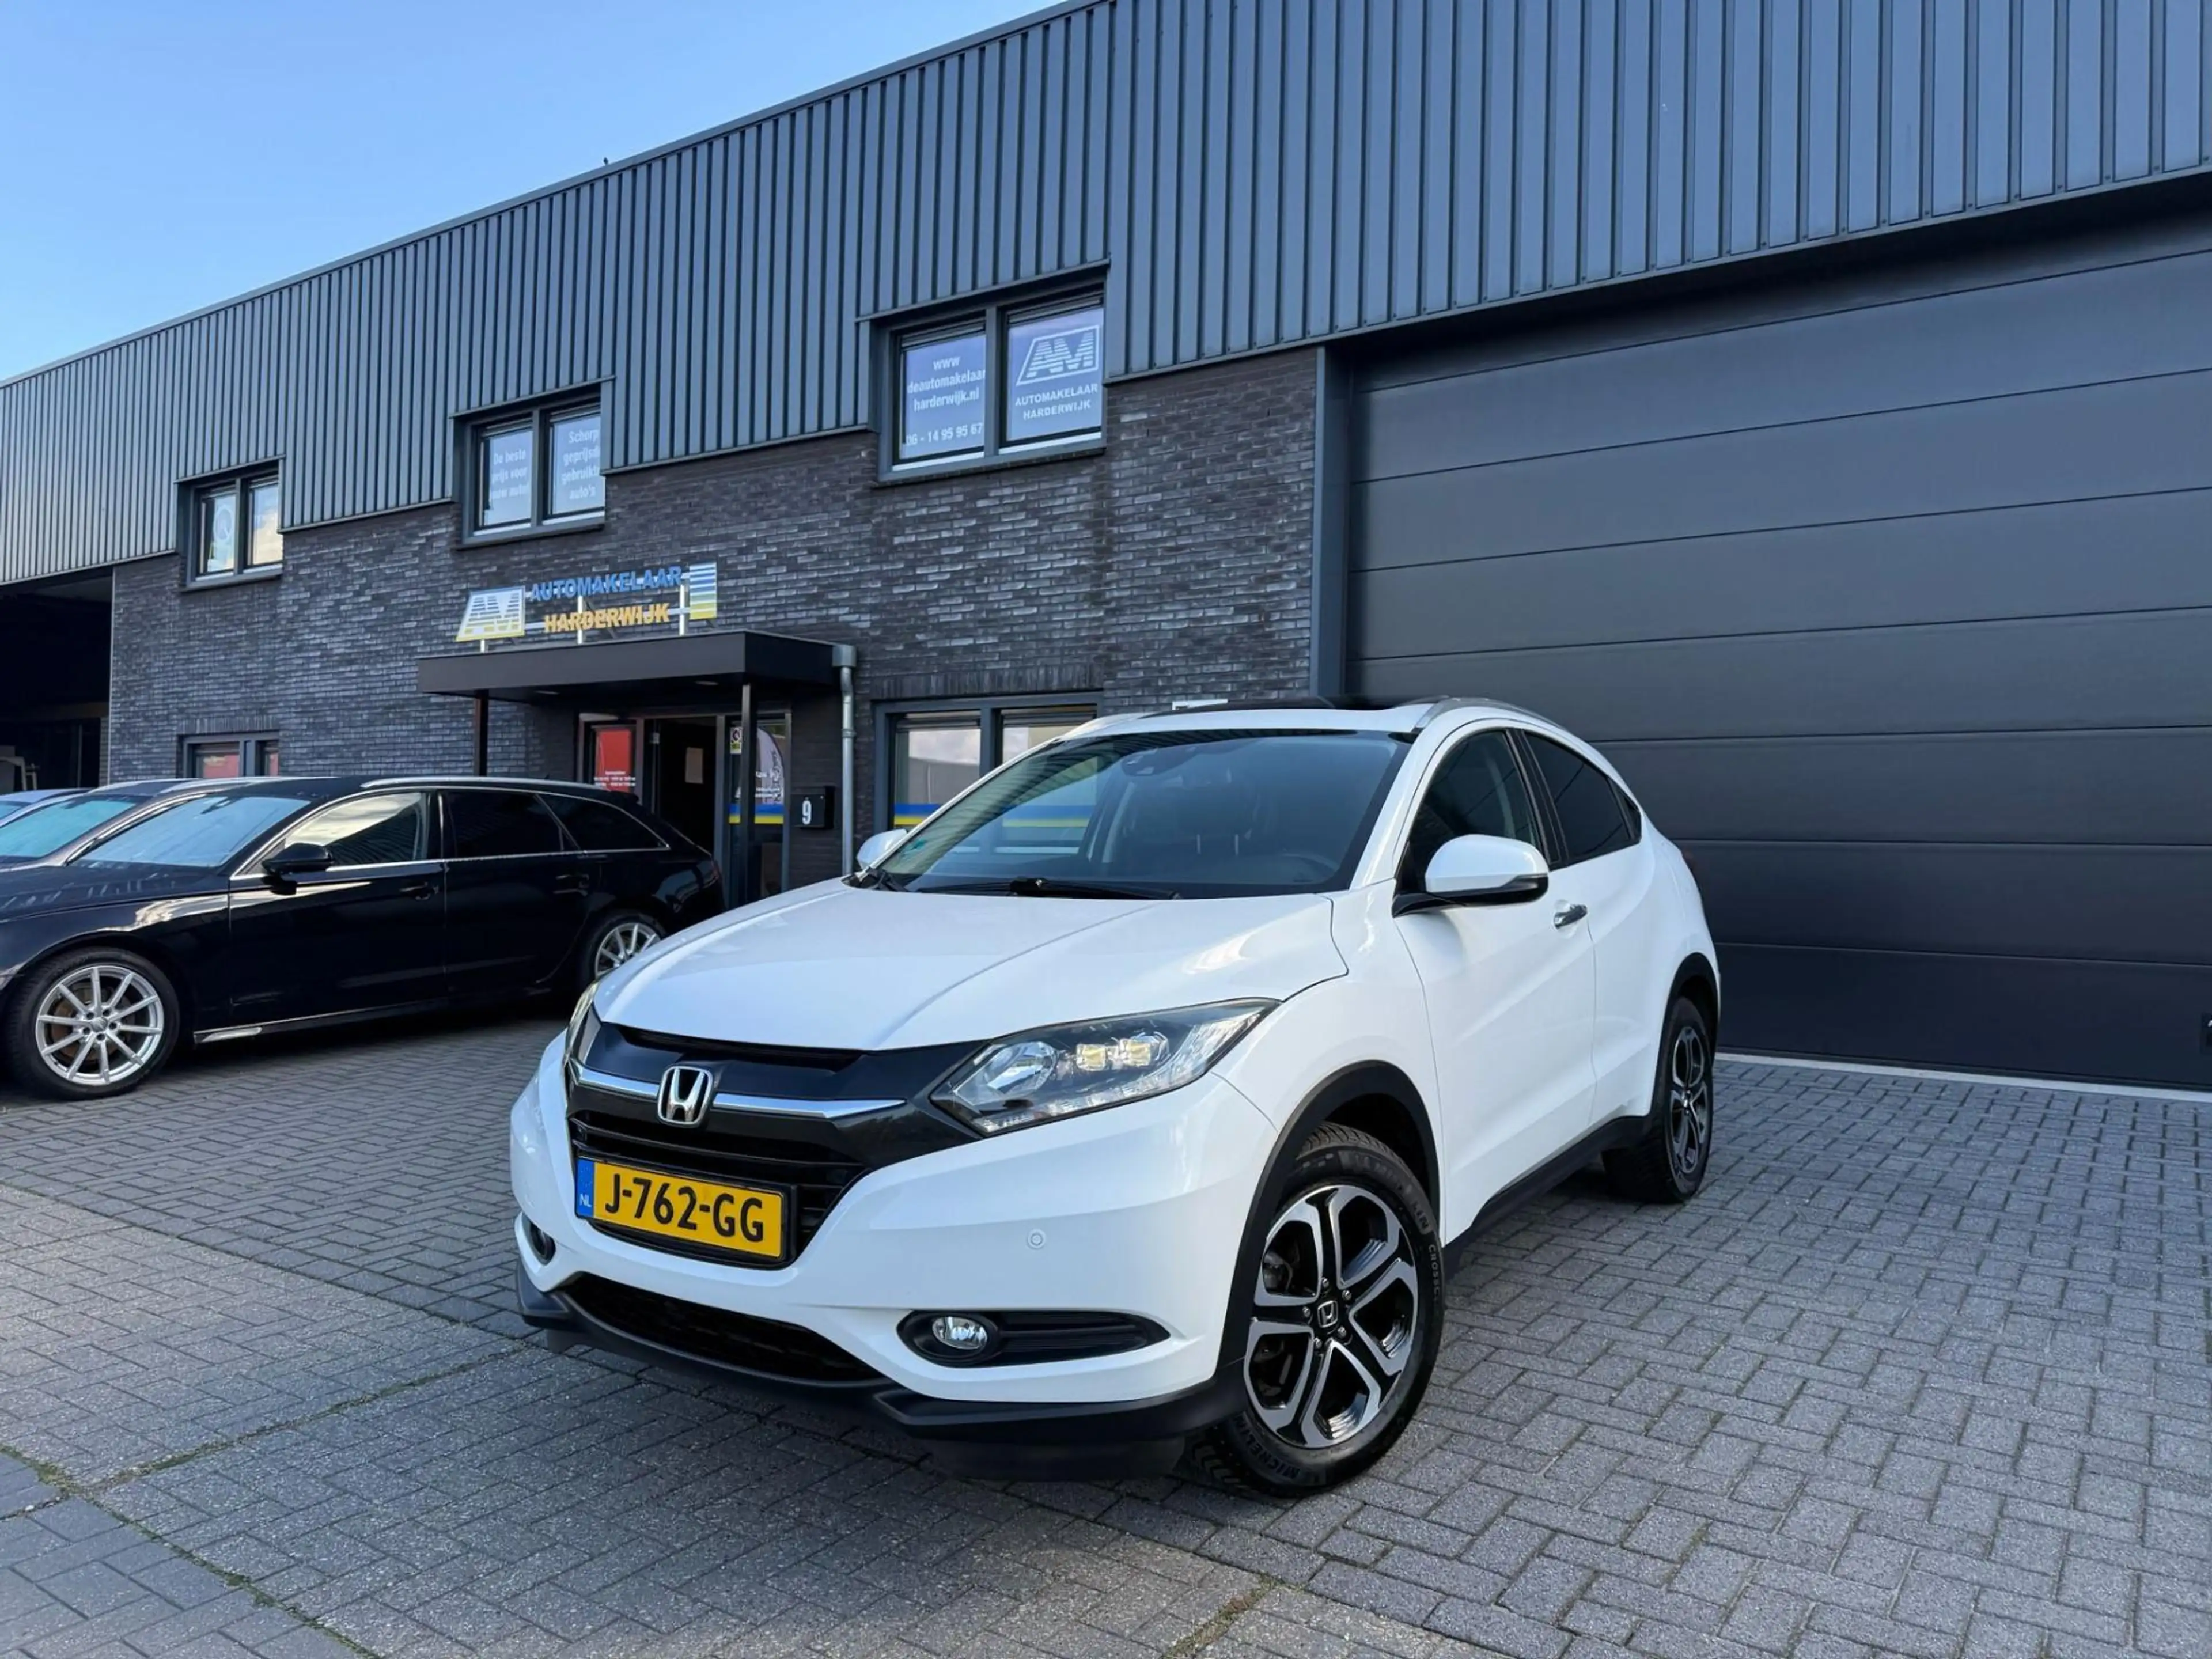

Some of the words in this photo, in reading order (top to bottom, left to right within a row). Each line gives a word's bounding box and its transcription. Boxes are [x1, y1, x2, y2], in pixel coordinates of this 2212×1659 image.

[933, 356, 960, 371] www
[914, 387, 979, 412] harderwijk.nl
[1016, 383, 1098, 407] AUTOMAKELAAR
[1023, 399, 1091, 420] HARDERWIJK
[928, 430, 940, 443] 14
[530, 565, 683, 602] AUTOMAKELAAR
[544, 603, 670, 633] HARDERWIJK
[802, 800, 812, 825] 9
[579, 1193, 592, 1208] NL
[605, 1173, 764, 1243] J-762-GG
